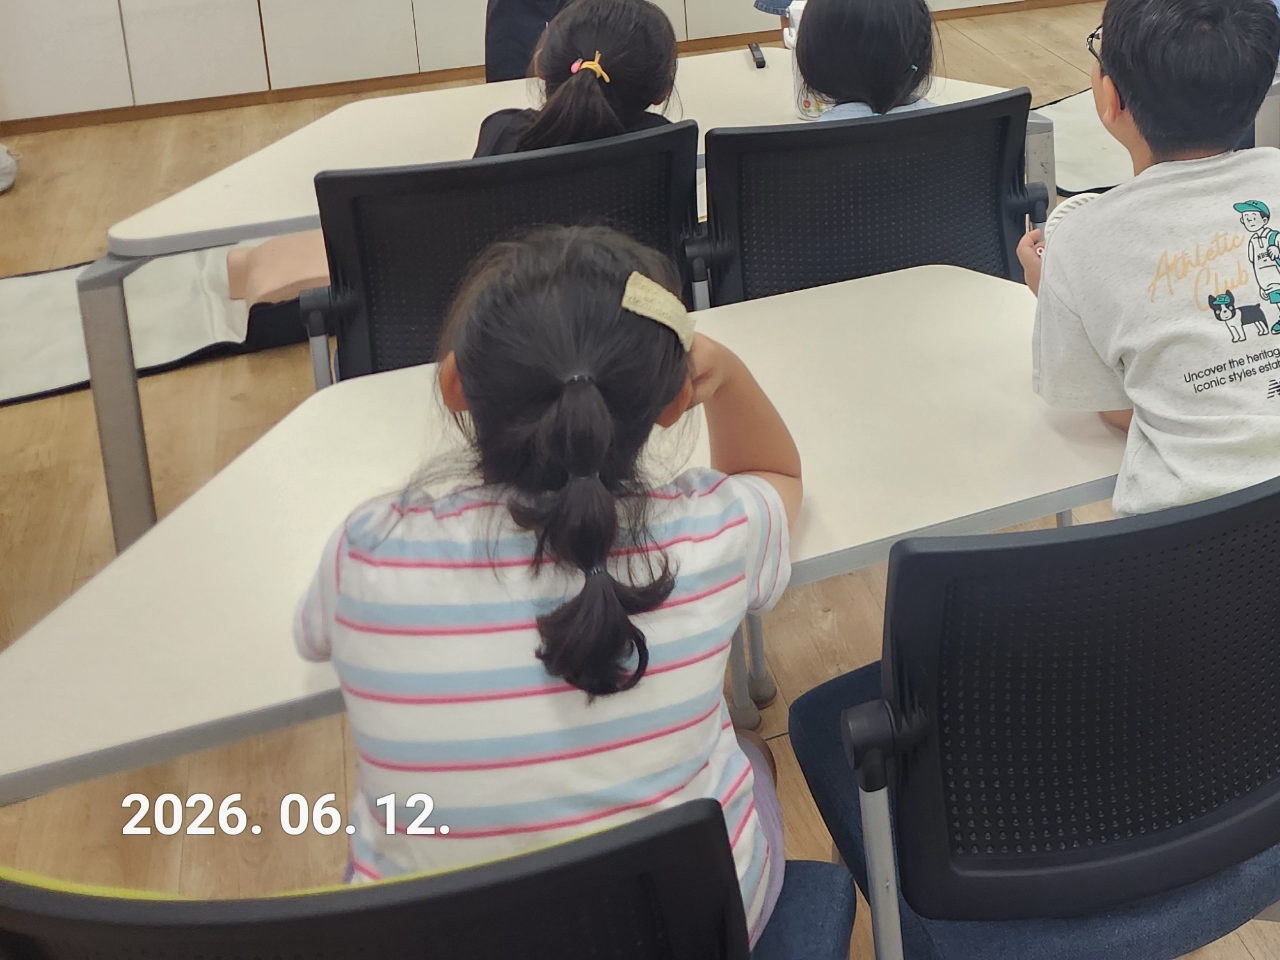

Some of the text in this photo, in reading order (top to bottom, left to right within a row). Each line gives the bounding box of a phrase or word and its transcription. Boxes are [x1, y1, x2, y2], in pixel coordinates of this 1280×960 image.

[1147, 232, 1245, 303] Athletic
[1193, 260, 1249, 312] Club
[1183, 362, 1227, 383] Uncover
[1228, 357, 1245, 370] the
[1193, 376, 1227, 394] iconic
[1228, 367, 1257, 383] styles
